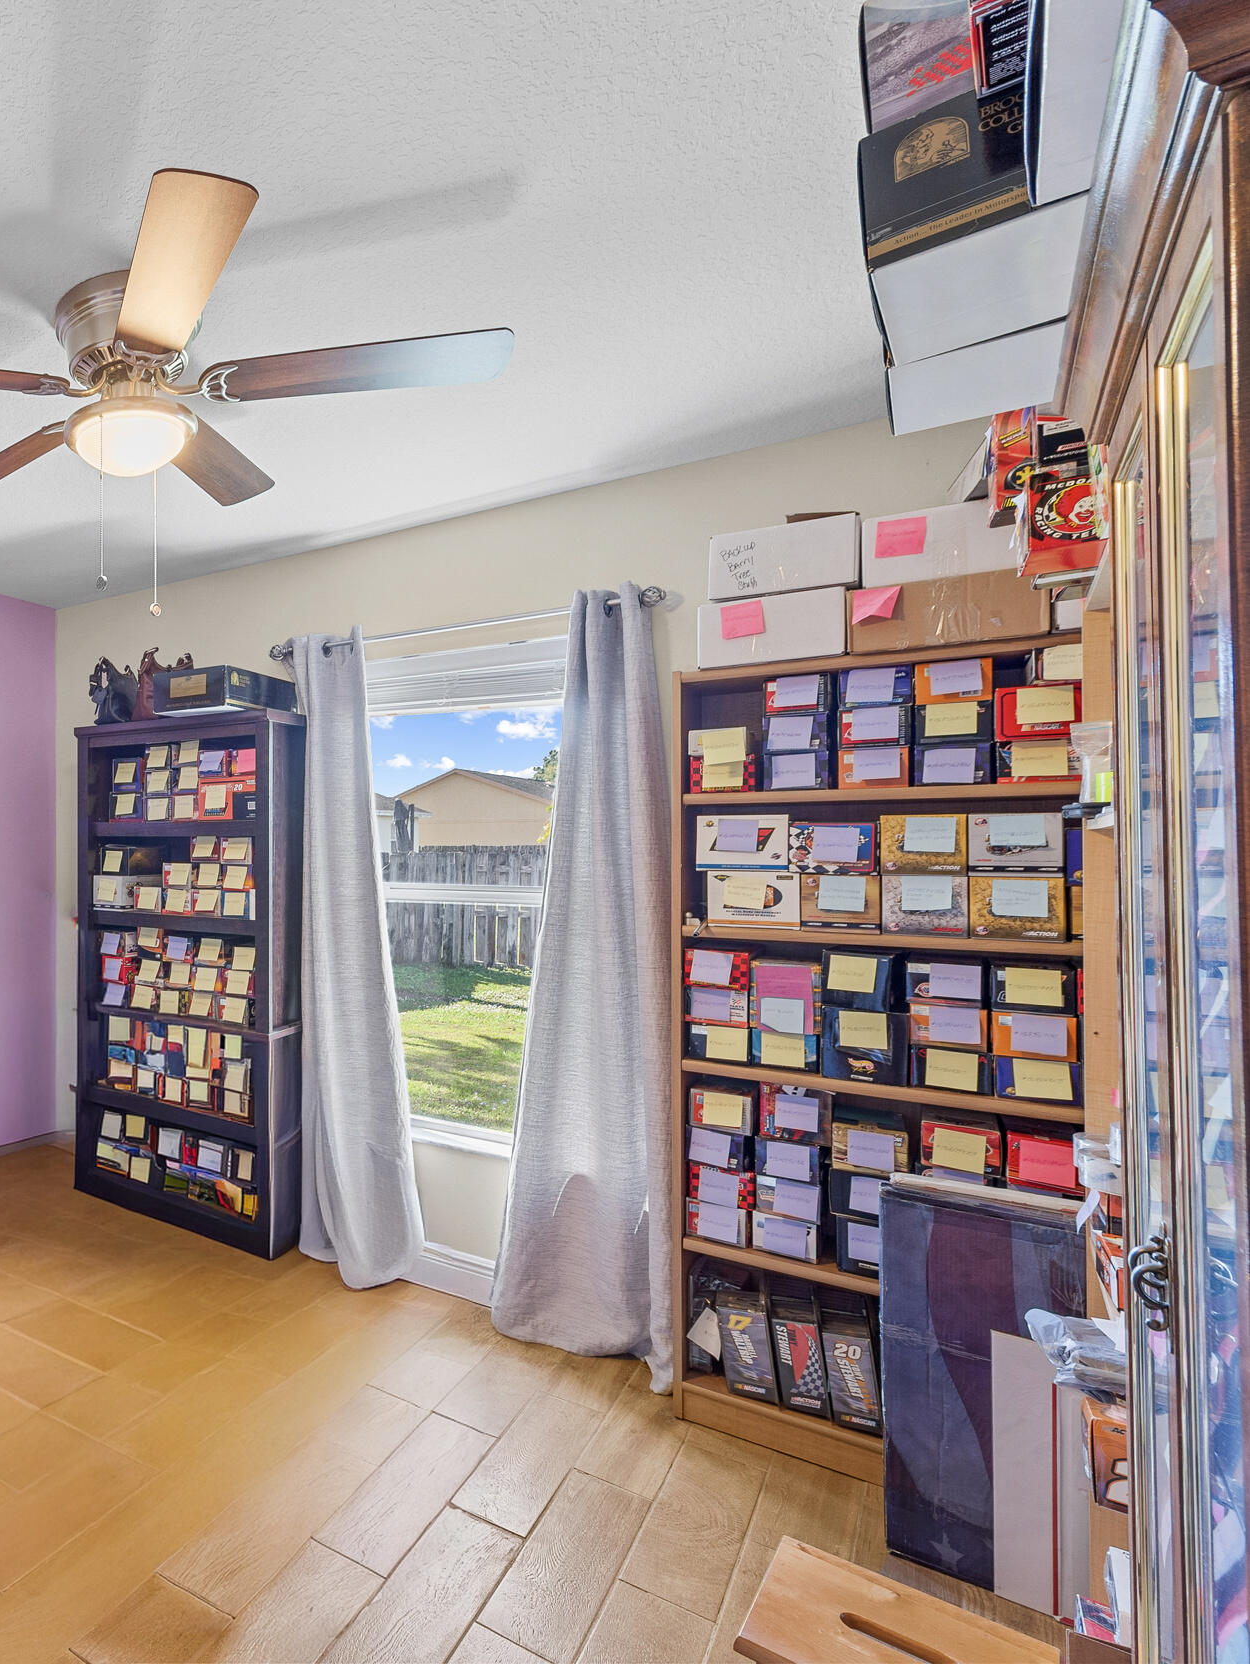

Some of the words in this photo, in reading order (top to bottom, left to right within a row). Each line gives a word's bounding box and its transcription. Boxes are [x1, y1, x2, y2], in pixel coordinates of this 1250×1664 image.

[1034, 506, 1063, 539] RACING
[727, 1314, 752, 1331] 17
[775, 1324, 793, 1366] STEWART
[786, 1328, 798, 1347] TONY
[729, 1330, 754, 1365] WALTRIP
[833, 1342, 862, 1360] 20
[836, 1358, 865, 1400] STEWART
[743, 1384, 766, 1394] NASCAR
[852, 1416, 876, 1426] NASCAR
